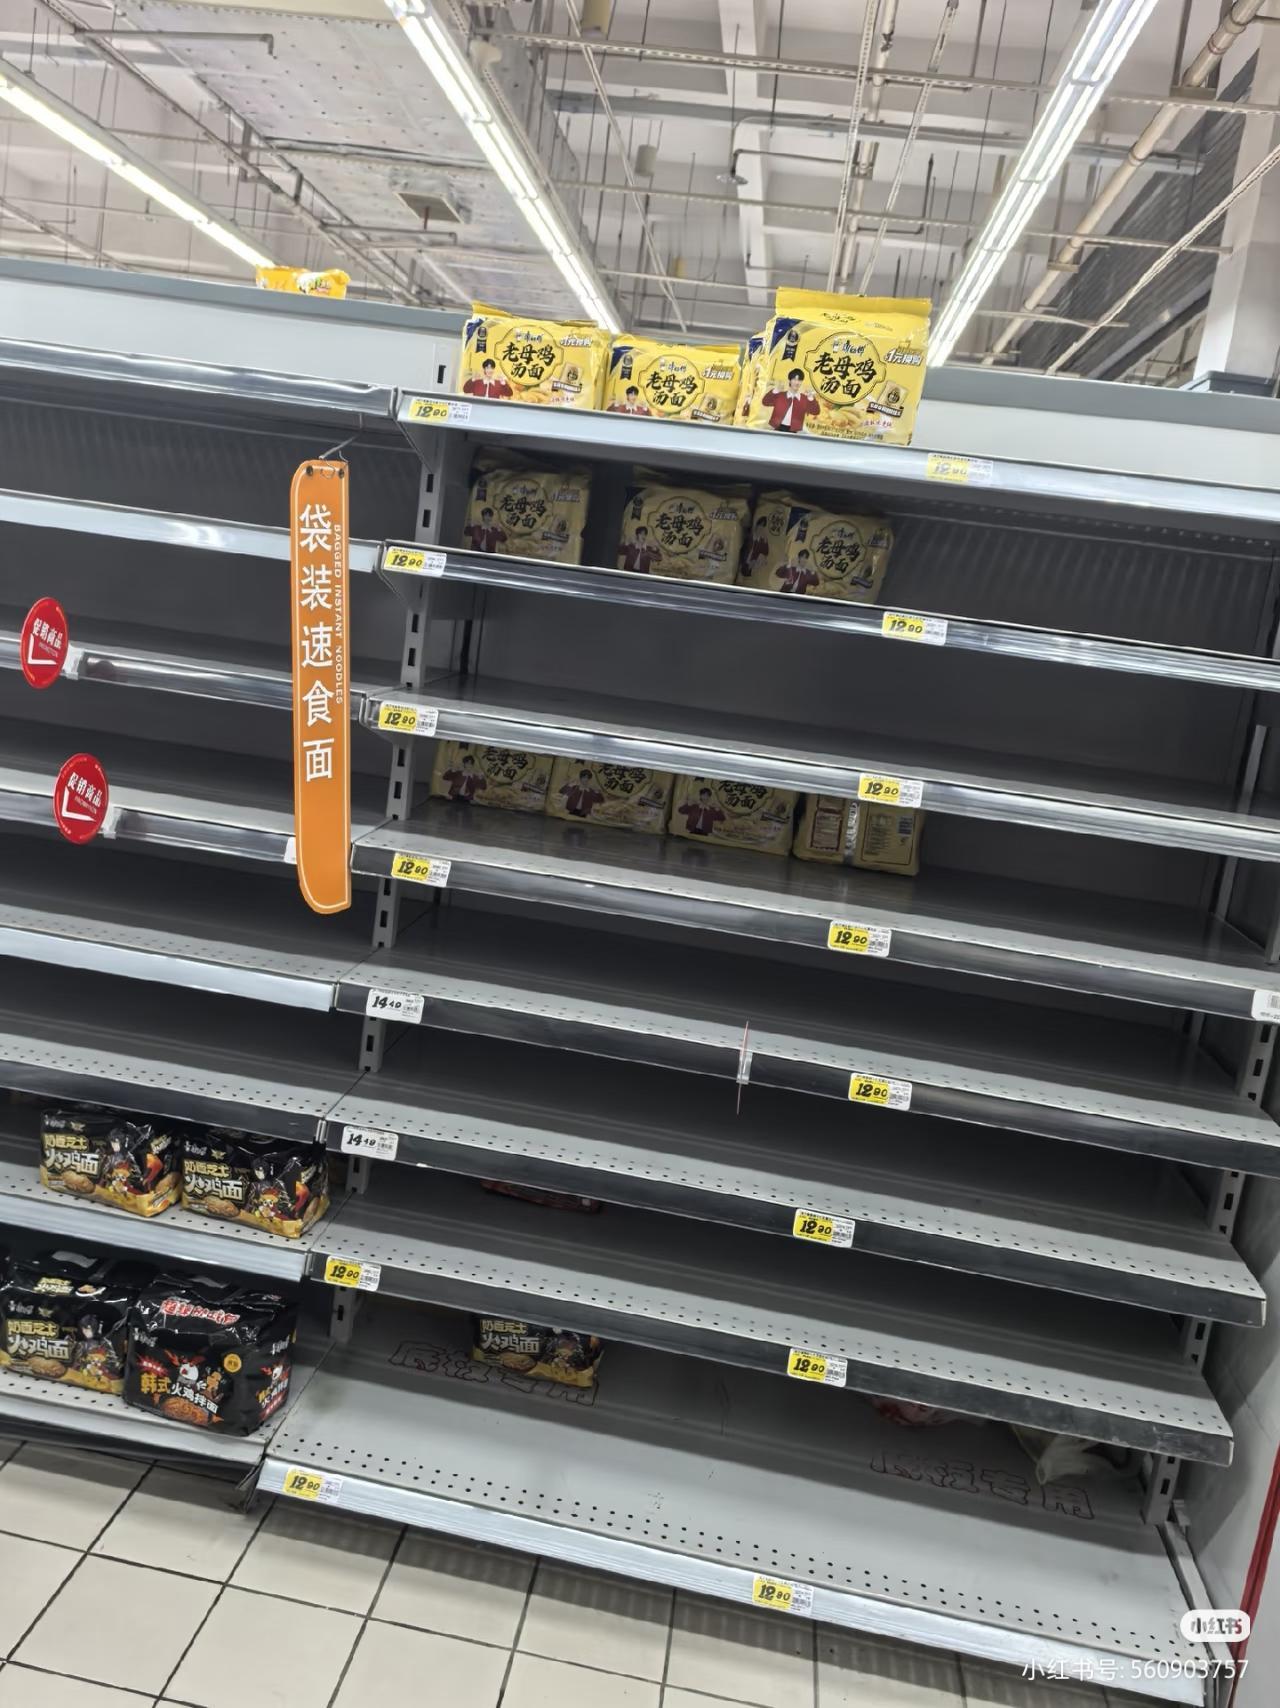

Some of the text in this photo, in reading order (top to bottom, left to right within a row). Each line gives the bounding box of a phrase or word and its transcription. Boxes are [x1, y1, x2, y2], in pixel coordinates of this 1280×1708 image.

[502, 342, 556, 366] 老母鸡
[511, 363, 545, 380] 汤面
[813, 352, 877, 383] 老母鸡
[645, 371, 698, 394] 老母鸡
[820, 376, 861, 398] 汤面
[653, 391, 687, 407] 汤面
[500, 495, 547, 517] 老母鸡
[655, 513, 704, 536] 老母鸡
[817, 536, 860, 562] 老母鸡
[334, 524, 344, 704] BAGGED INSTANT NOODLES
[300, 504, 334, 782] 袋装速食面
[45, 1149, 99, 1175] 火鸡面
[184, 1174, 243, 1201] 火鸡面
[7, 1335, 70, 1360] 火鸡面
[482, 1332, 540, 1353] 火鸡面
[140, 1372, 172, 1394] 韩式
[171, 1383, 218, 1414] 火鸡拌面
